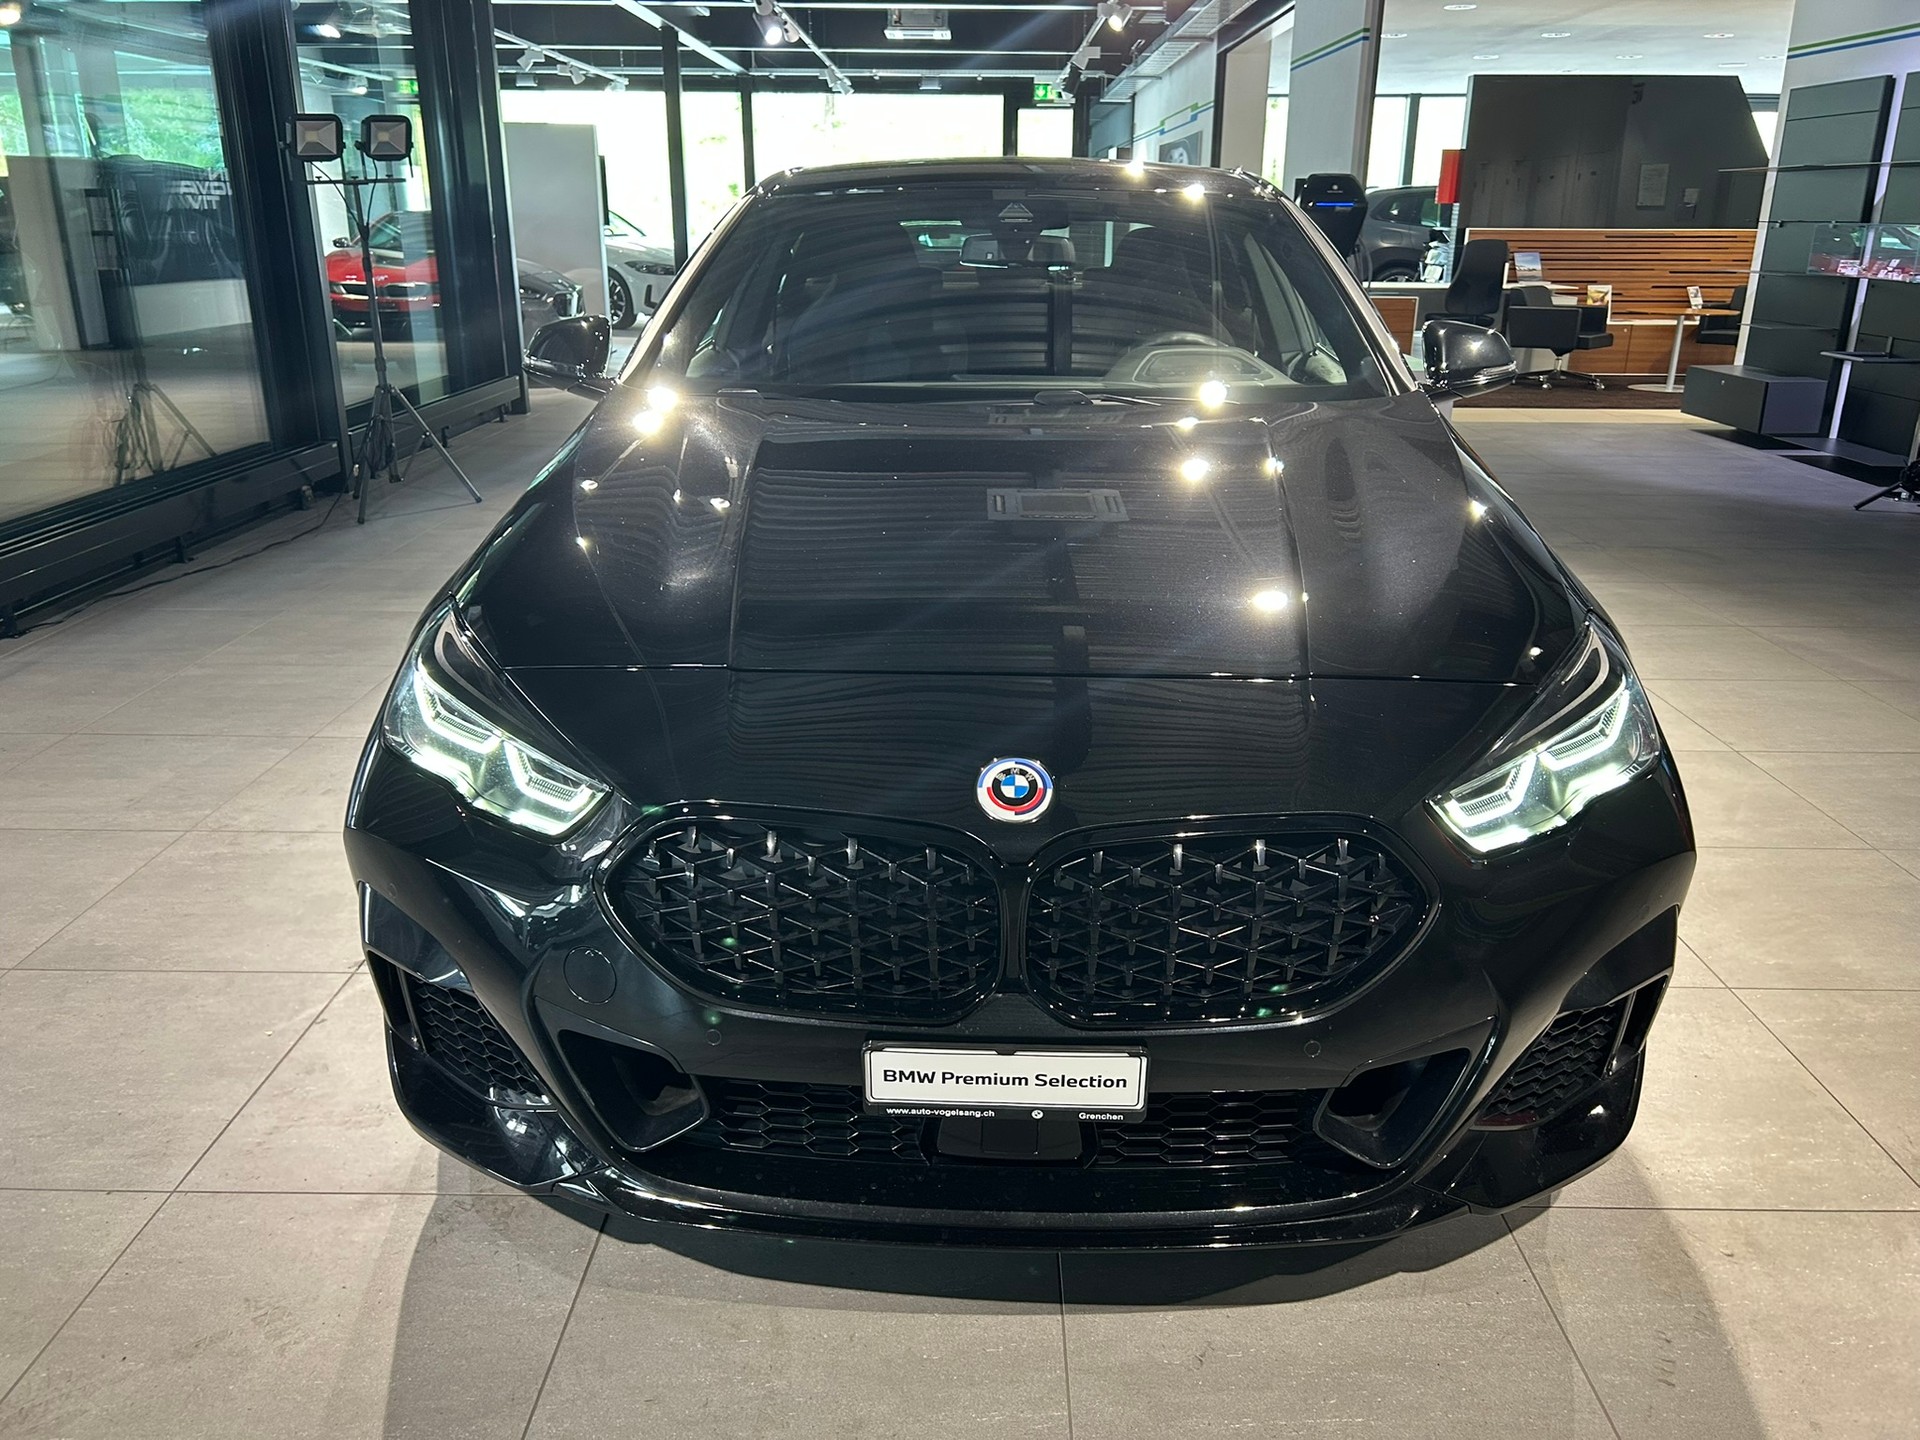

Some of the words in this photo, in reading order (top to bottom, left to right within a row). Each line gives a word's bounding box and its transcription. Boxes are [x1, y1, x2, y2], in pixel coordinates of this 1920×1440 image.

[994, 767, 1036, 782] BMW
[883, 1069, 936, 1084] BMW
[941, 1071, 1029, 1087] Premium
[1034, 1073, 1127, 1089] Selection
[886, 1107, 996, 1118] www.auto-vogelsang.ch
[1078, 1112, 1124, 1121] Grenchen
